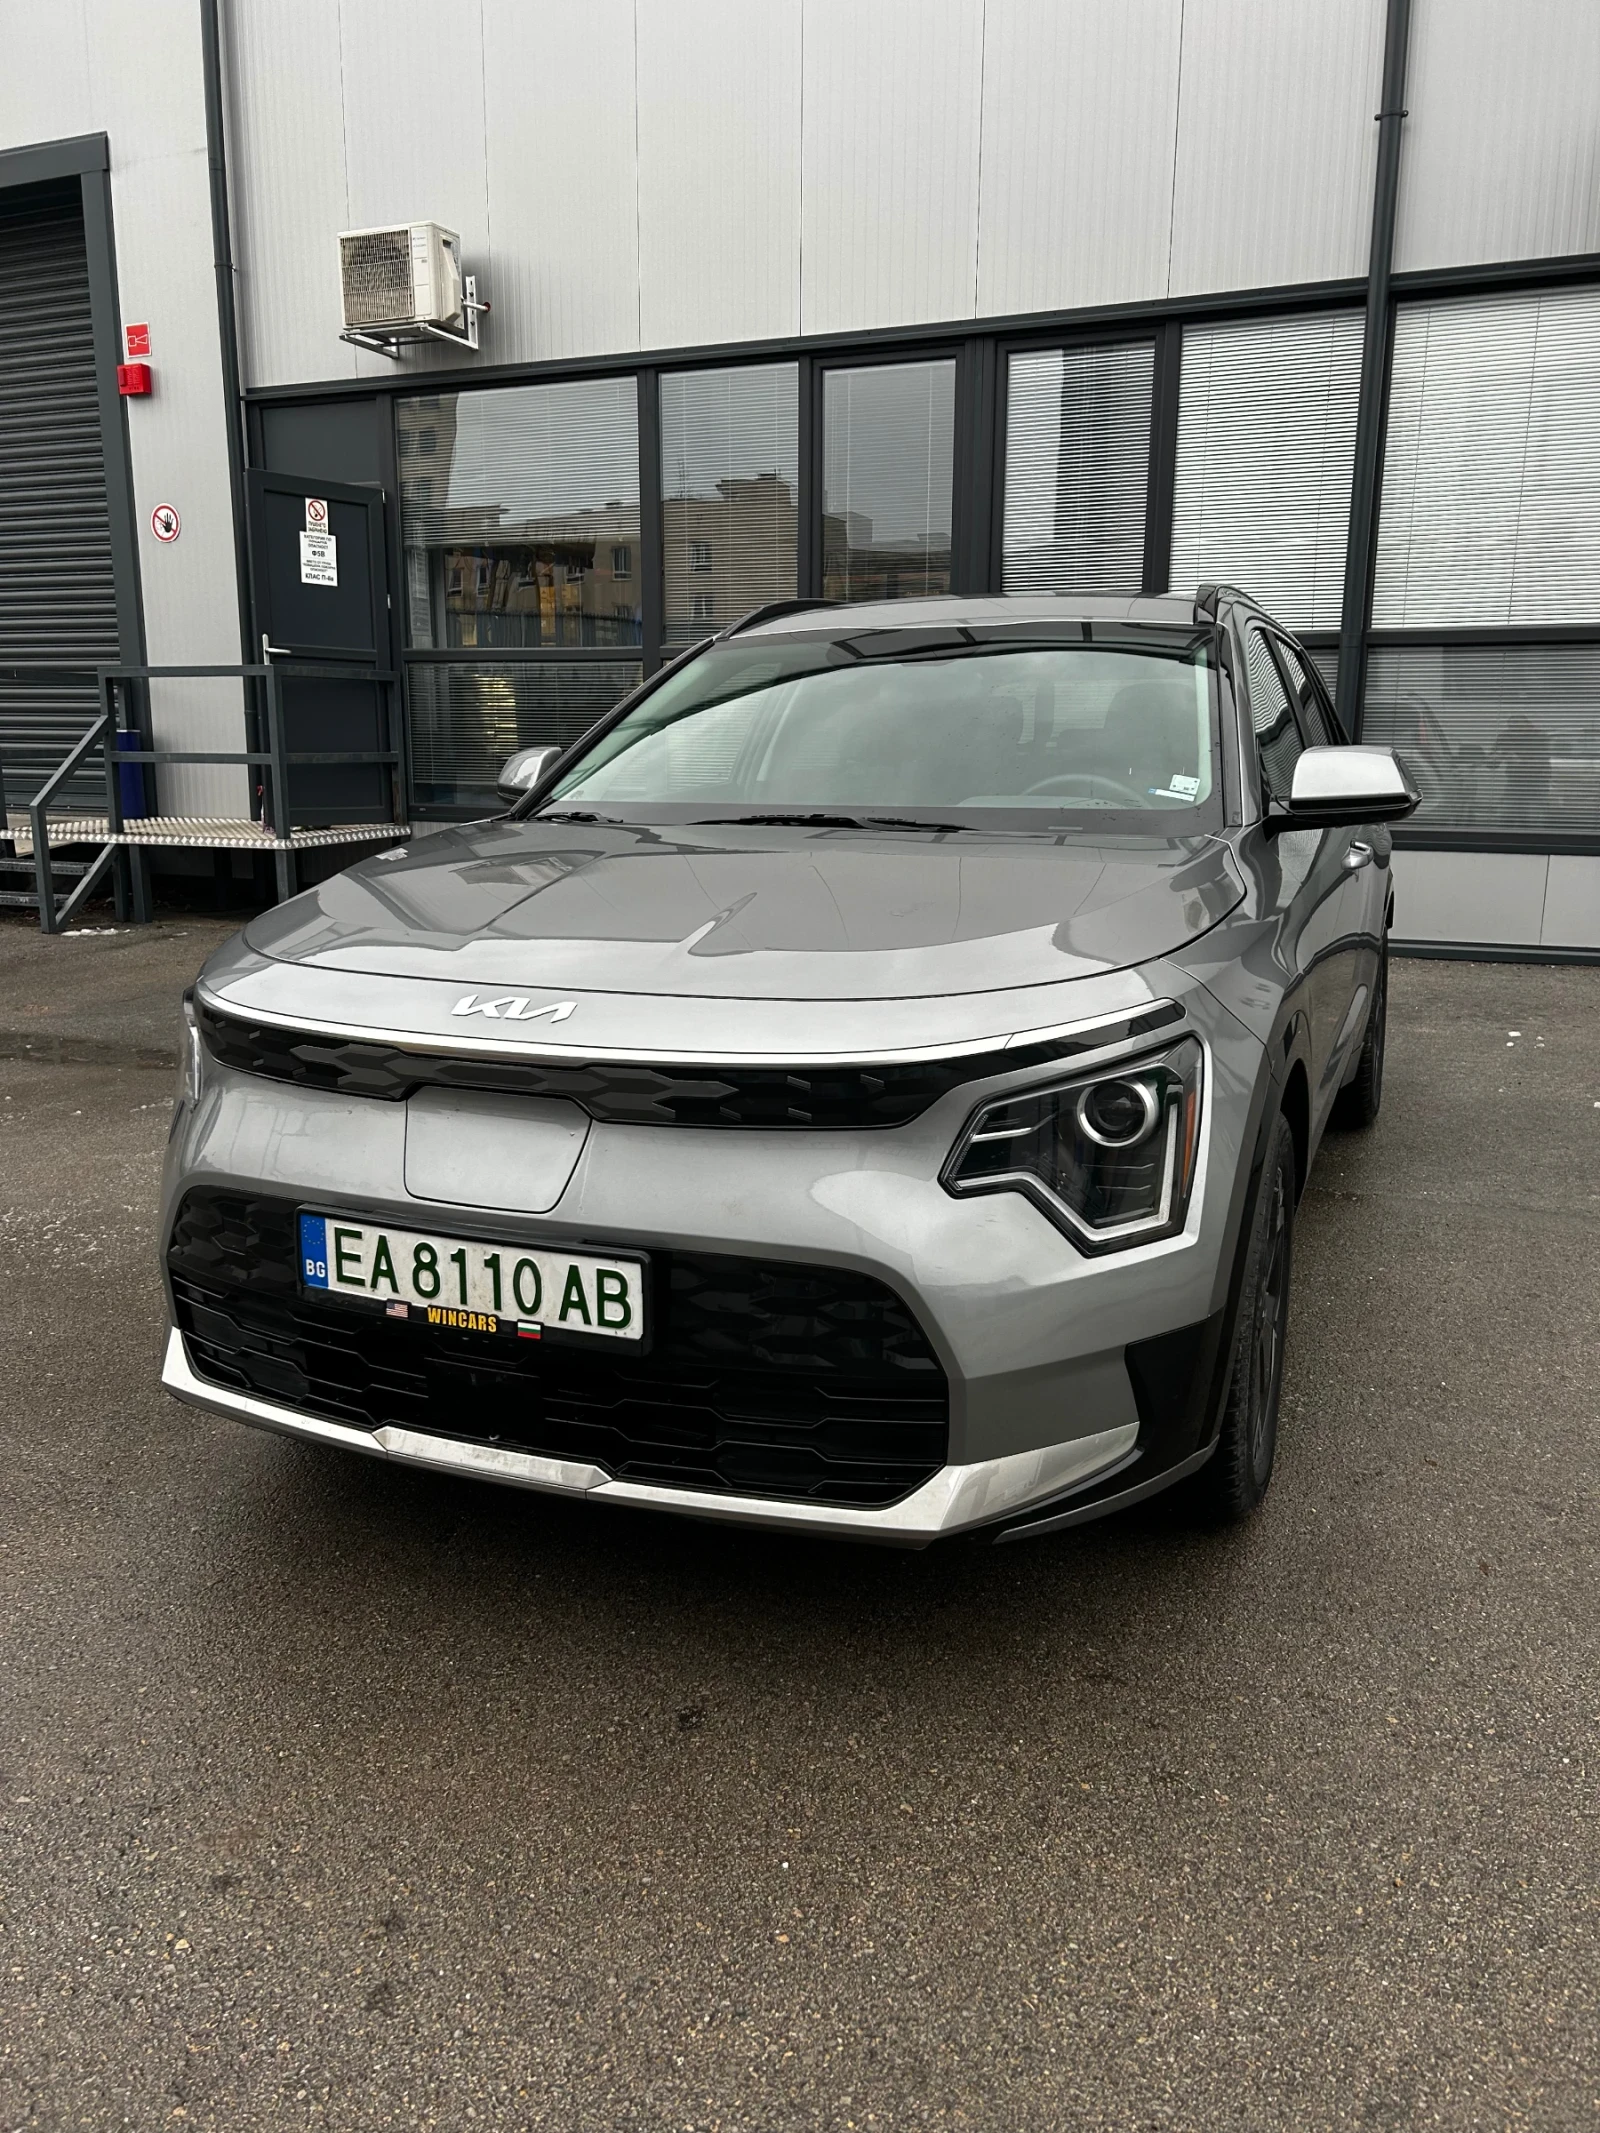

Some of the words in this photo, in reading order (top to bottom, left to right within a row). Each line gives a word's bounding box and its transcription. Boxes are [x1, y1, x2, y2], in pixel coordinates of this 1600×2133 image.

[451, 994, 578, 1024] KIA
[305, 1258, 326, 1278] BG
[334, 1226, 400, 1294] EA
[412, 1241, 543, 1316] 8110
[558, 1263, 633, 1330] AB
[427, 1305, 497, 1333] WINCARS
